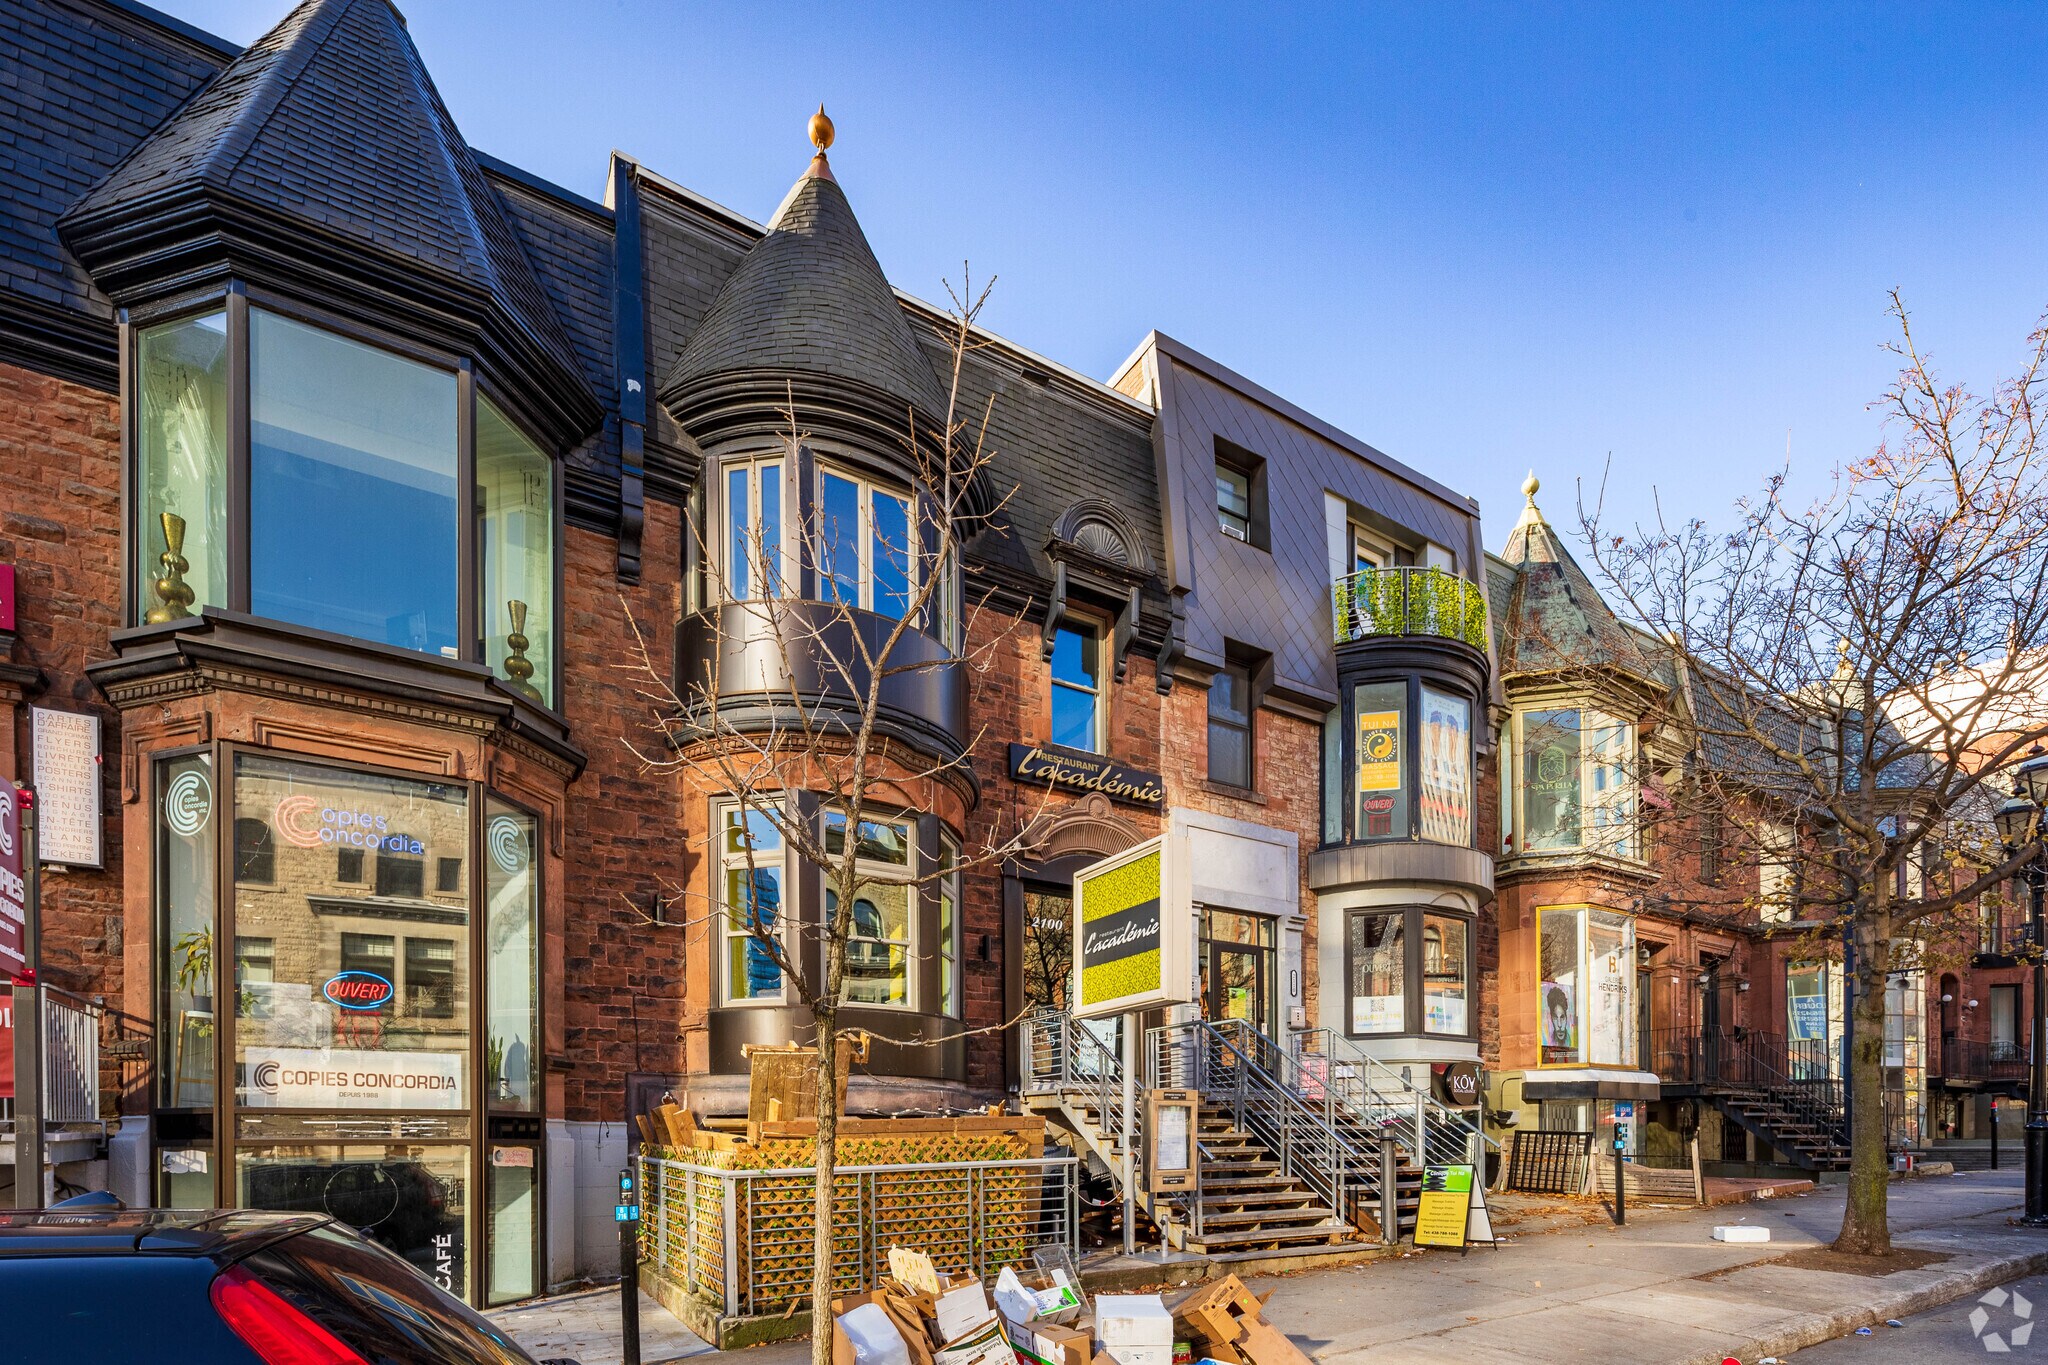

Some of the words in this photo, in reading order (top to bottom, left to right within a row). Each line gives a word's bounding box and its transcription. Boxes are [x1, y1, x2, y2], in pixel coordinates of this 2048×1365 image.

[37, 712, 91, 727] CARTES
[37, 719, 90, 733] D'AFFAIRE
[1382, 720, 1398, 728] NA
[37, 728, 63, 736] GRAND
[37, 735, 91, 750] FLYERS
[1041, 753, 1100, 773] RESTAURANT
[37, 766, 91, 780] POSTERS
[38, 782, 92, 796] T-SHIRTS
[39, 800, 92, 812] MENUS
[1364, 799, 1394, 810] OUVERT
[39, 831, 93, 844] PLANS
[40, 848, 92, 861] TICKETS
[1031, 916, 1063, 930] 2100
[326, 981, 389, 1000] OUVERT
[281, 1069, 348, 1087] COPIES
[353, 1072, 457, 1090] CONCORDIA
[431, 1234, 452, 1290] CAFÉ
